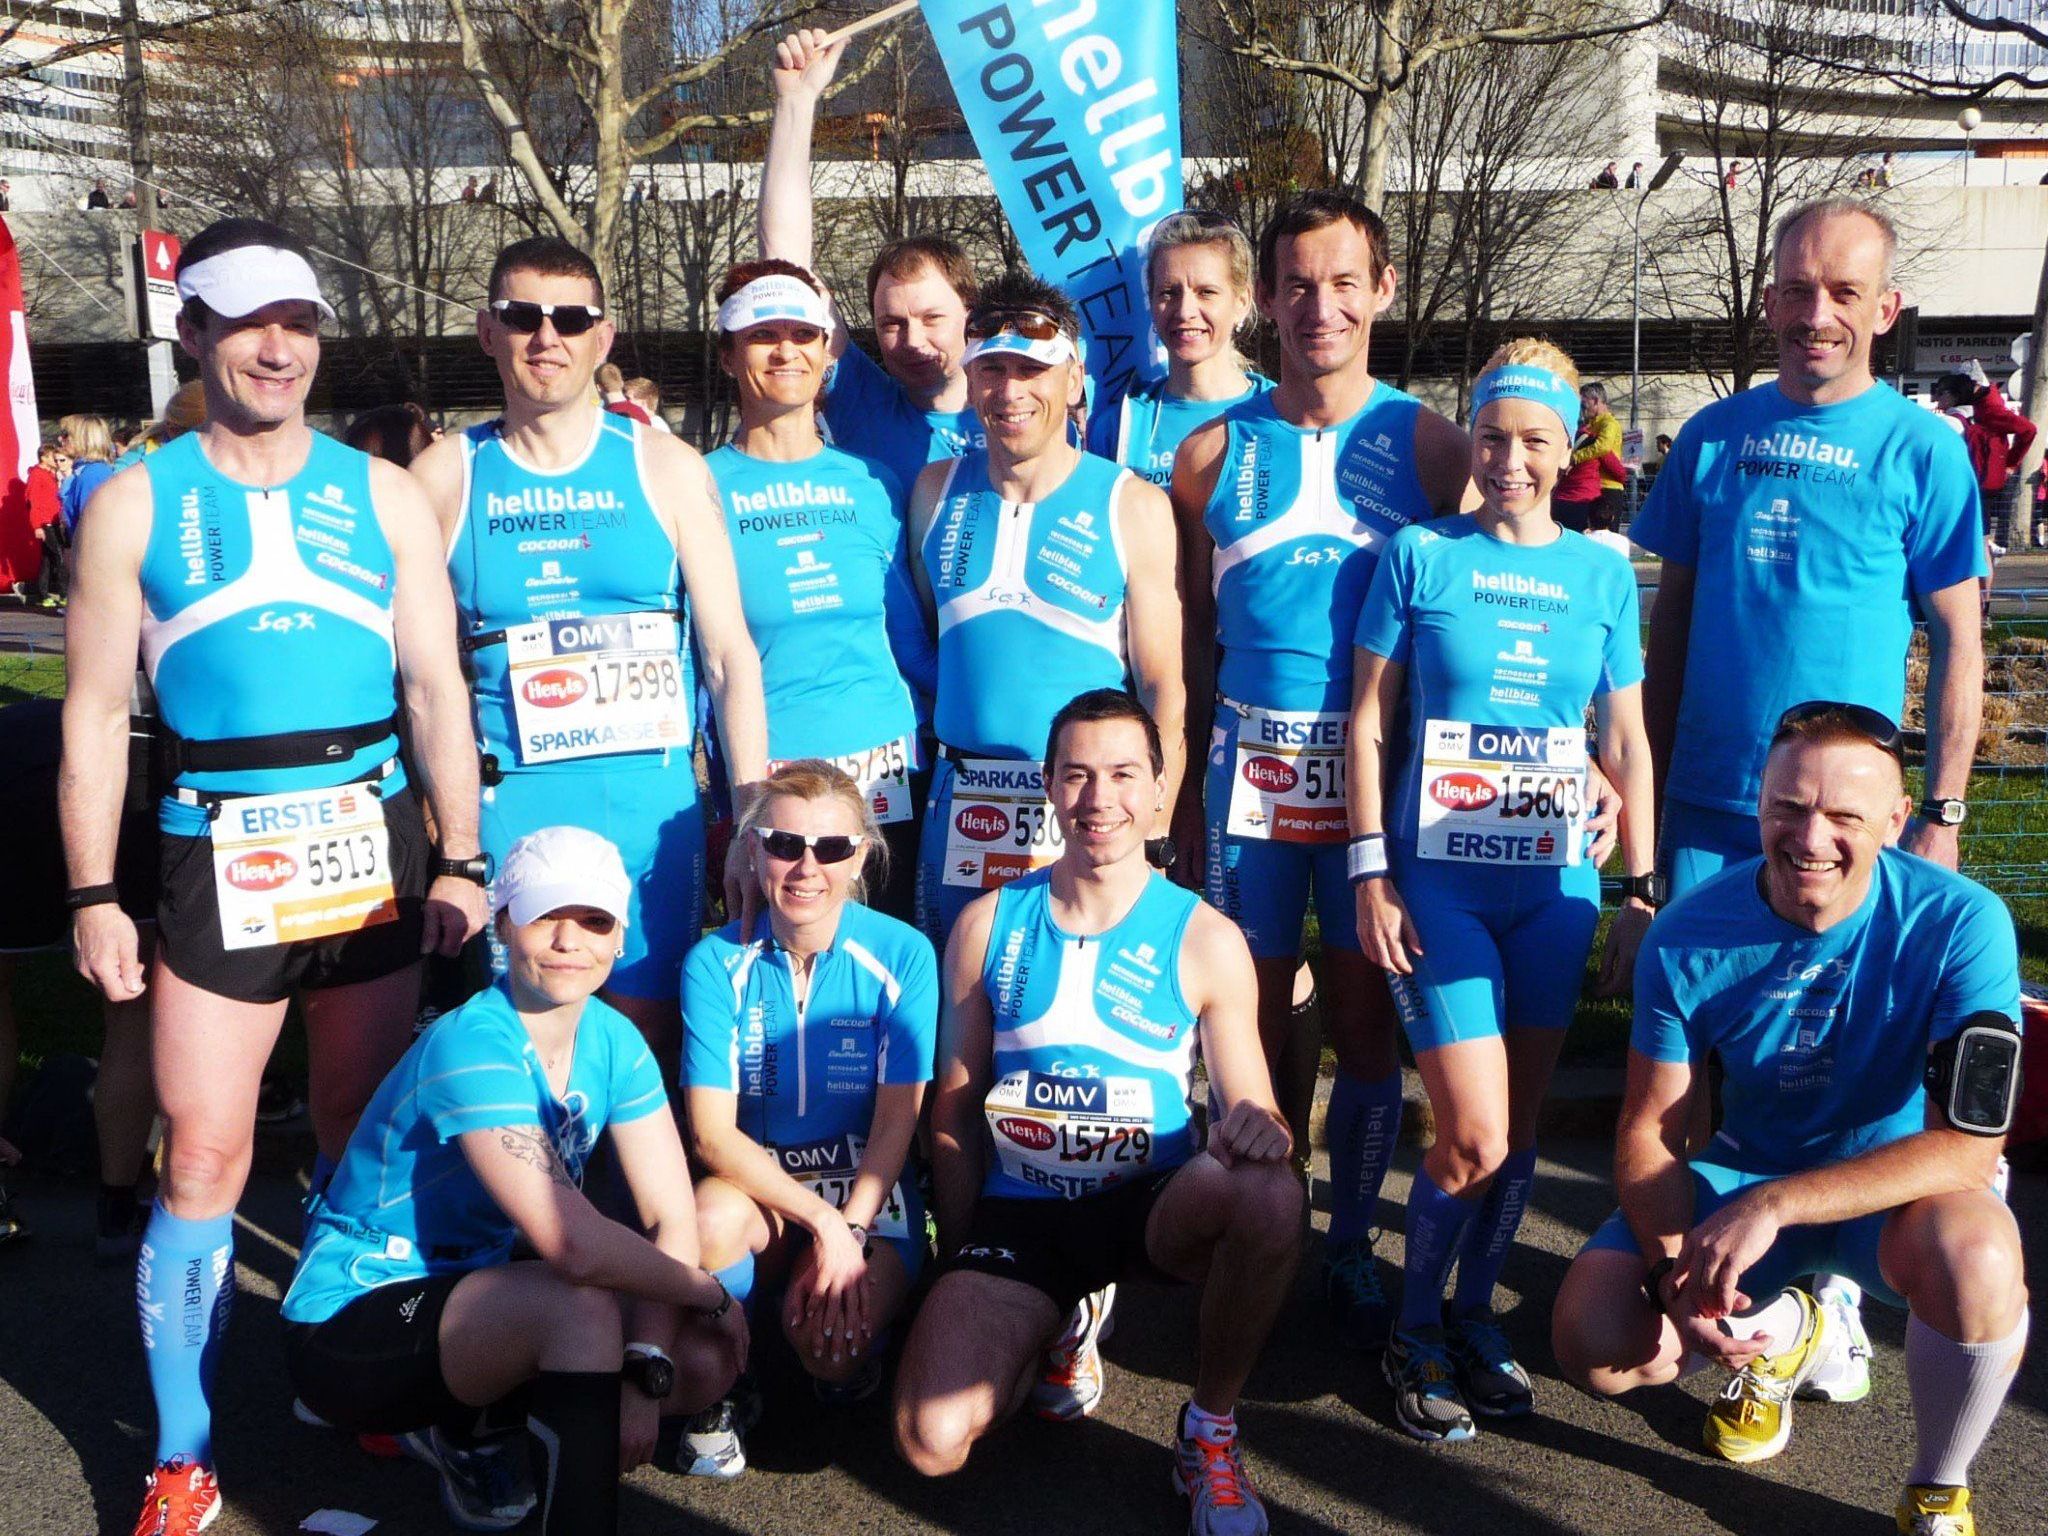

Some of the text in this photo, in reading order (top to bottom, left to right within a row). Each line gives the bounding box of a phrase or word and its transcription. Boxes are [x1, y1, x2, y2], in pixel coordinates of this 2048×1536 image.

[1957, 336, 2006, 348] PARKEN
[1740, 433, 1860, 469] hellblau.
[1235, 434, 1259, 521] hellblau.
[1255, 432, 1273, 520] POWERTEAM
[1735, 459, 1857, 490] POWERTEAM
[487, 487, 625, 517] hellblau.
[731, 480, 855, 515] hellblau.
[178, 487, 206, 586] hellblau.
[204, 485, 226, 582] POWERTEAM
[488, 511, 629, 535] POWERTEAM
[738, 509, 858, 535] POWERTEAM
[518, 537, 582, 554] cocoon
[938, 492, 970, 588] hellblau.
[954, 489, 984, 587] POWERTEAM
[1472, 569, 1570, 600] hellblau.
[1474, 591, 1569, 616] POWERTEAM
[558, 623, 623, 649] OMV
[527, 679, 584, 701] Hervis
[591, 659, 678, 704] 17598
[530, 722, 655, 753] SPARKASSE
[1260, 718, 1338, 745] ERSTE
[1477, 732, 1541, 757] OMV
[834, 739, 904, 782] 5735
[1247, 760, 1293, 787] Hervis
[1305, 759, 1346, 800] 51
[1436, 779, 1493, 805] Hervis
[1500, 775, 1581, 819] 15603
[241, 799, 334, 834] ERSTE
[961, 812, 1006, 833] Hervis
[1278, 818, 1313, 830] WIEN
[307, 834, 376, 887] 5513
[1446, 832, 1533, 861] ERSTE
[231, 858, 293, 884] Hervis
[988, 865, 1021, 877] WIEN
[996, 926, 1026, 1016] hellblau.
[1011, 926, 1041, 1019] POWERTEAM
[745, 1000, 764, 1096] hellblau.
[764, 999, 778, 1097] POWERTEAM
[1034, 1081, 1098, 1108] OMV
[1001, 1120, 1051, 1143] Hervis
[1058, 1123, 1150, 1163] 15729
[786, 1144, 838, 1167] OMV
[1021, 1162, 1098, 1198] ERSTE
[184, 1257, 202, 1348] POWERTEAM
